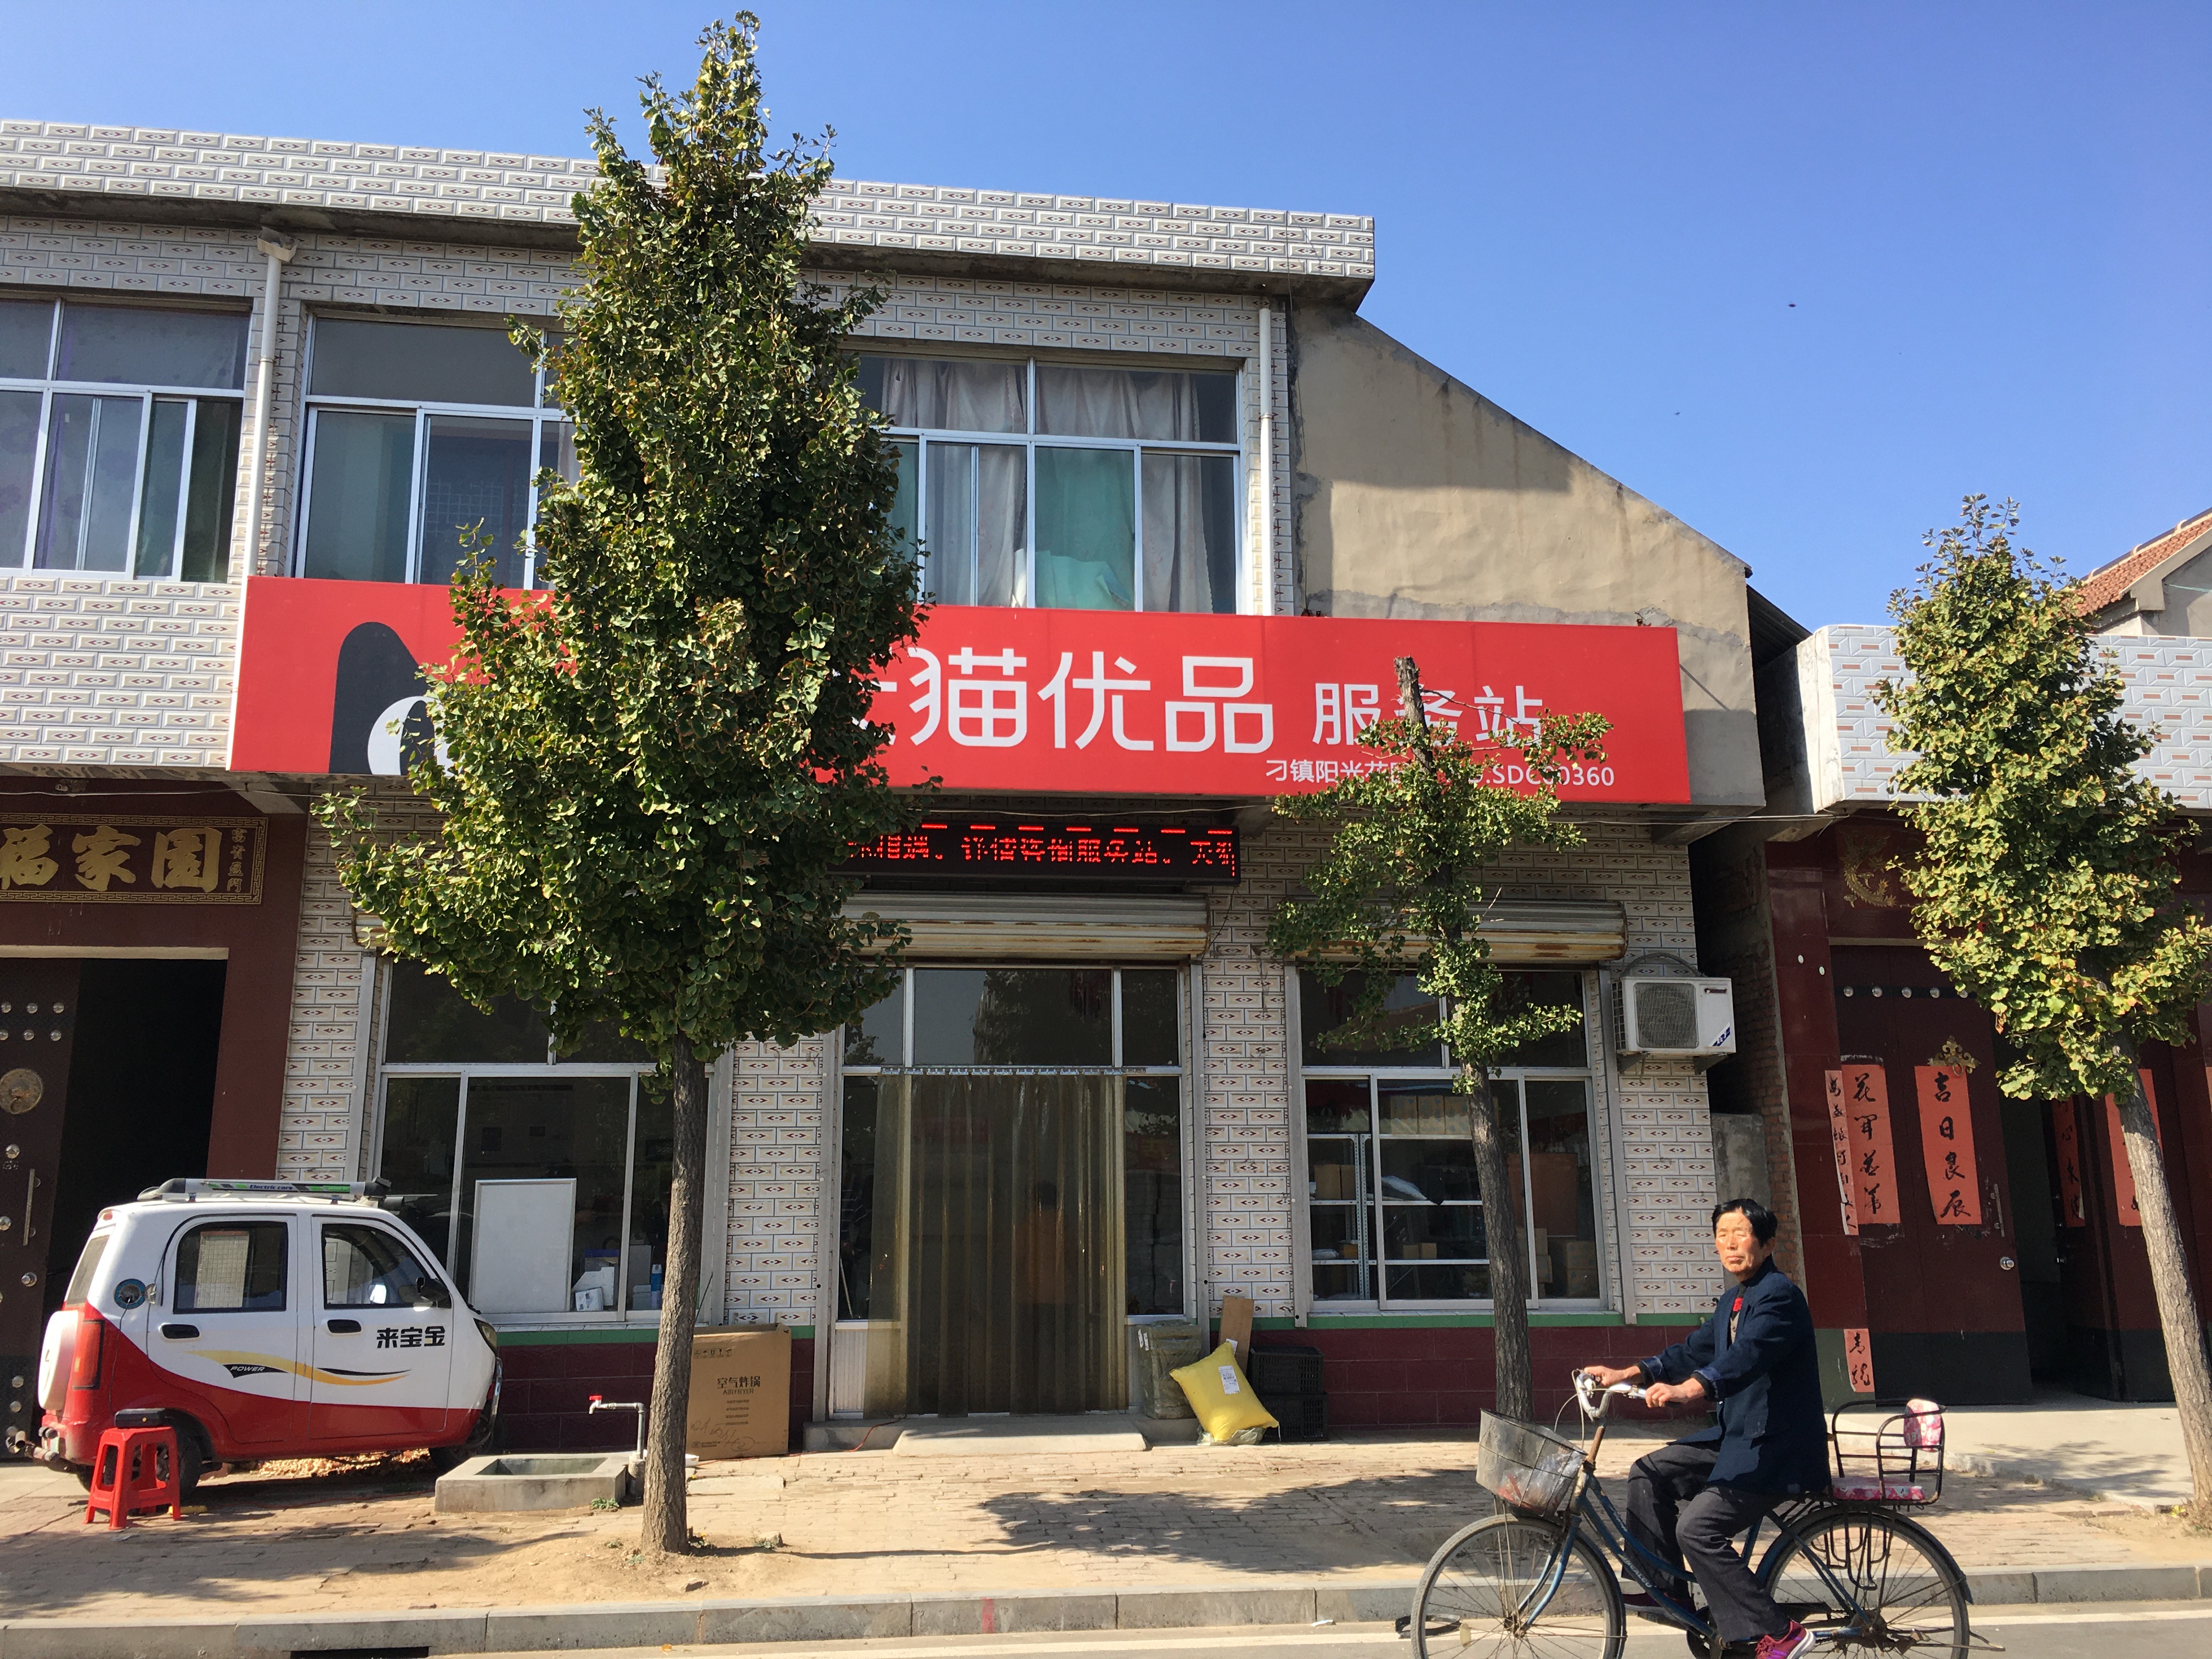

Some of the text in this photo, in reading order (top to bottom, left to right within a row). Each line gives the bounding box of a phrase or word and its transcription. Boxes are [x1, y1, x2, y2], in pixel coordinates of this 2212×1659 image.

[1312, 682, 1543, 747] 服务站
[1934, 1071, 1971, 1218] 吉日良辰
[716, 1376, 761, 1389] 空气炸锅
